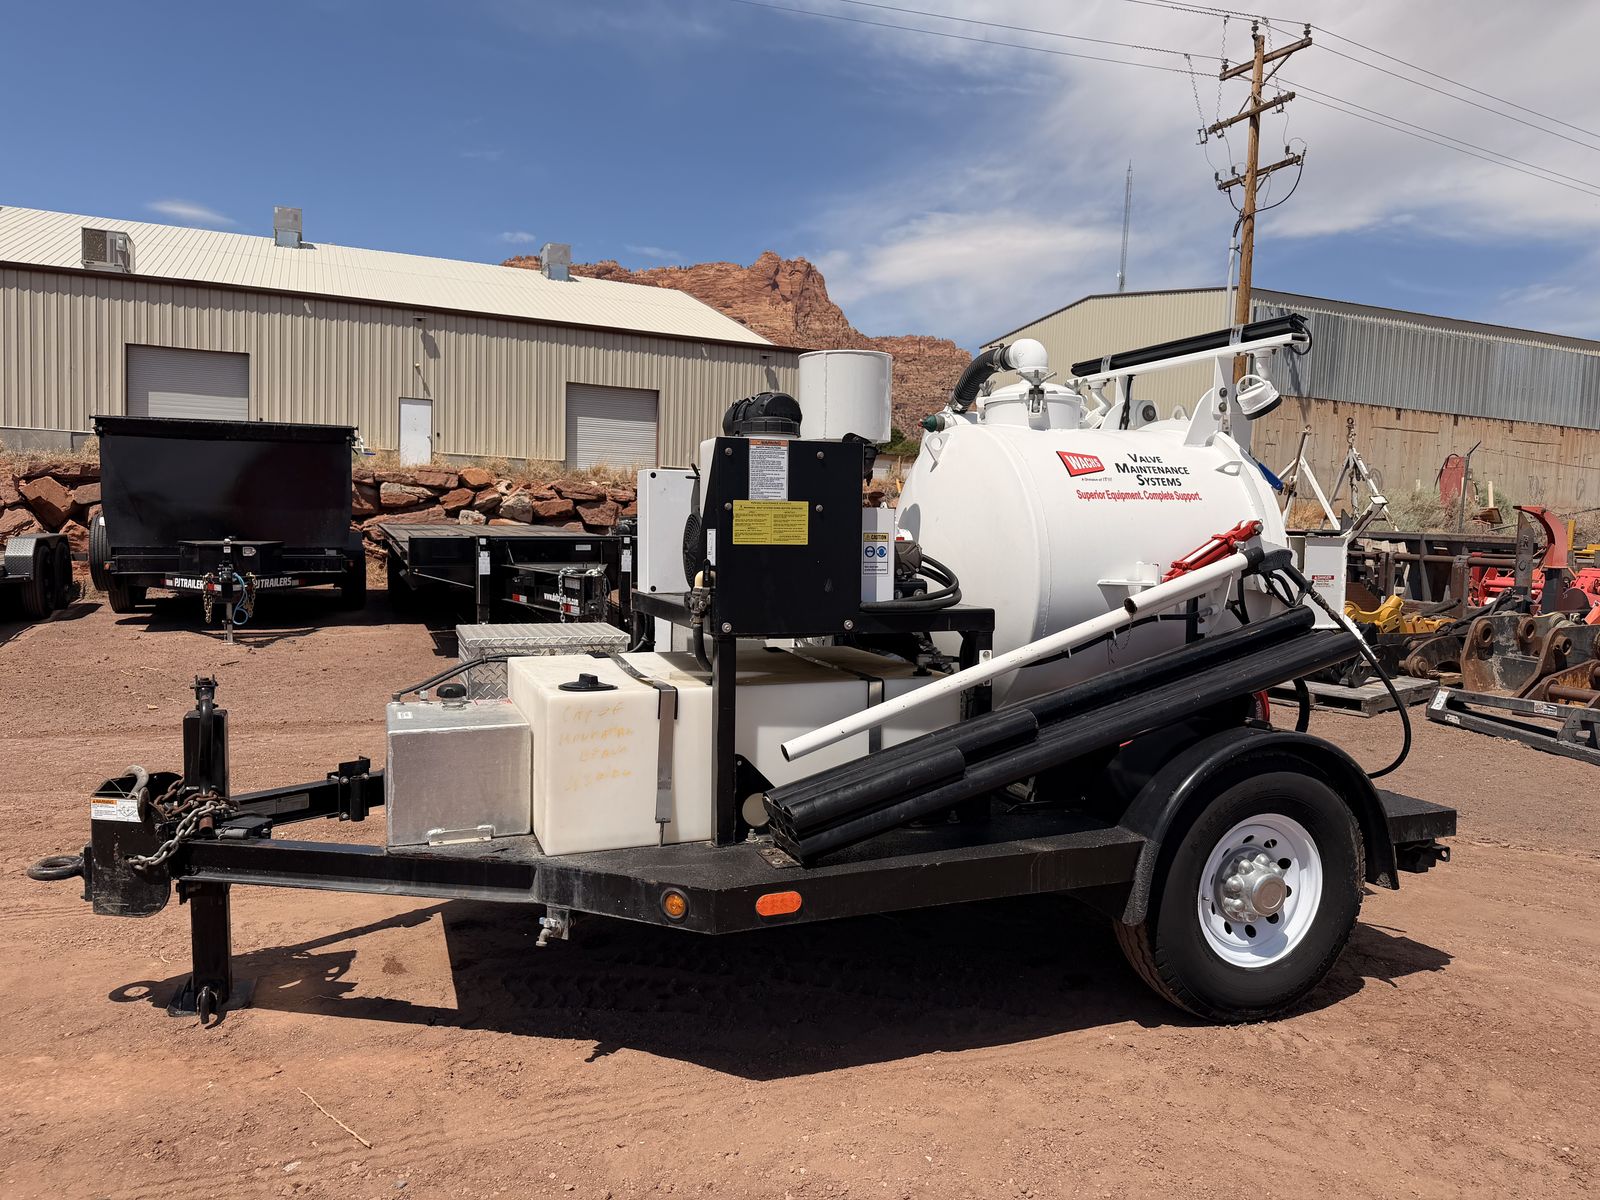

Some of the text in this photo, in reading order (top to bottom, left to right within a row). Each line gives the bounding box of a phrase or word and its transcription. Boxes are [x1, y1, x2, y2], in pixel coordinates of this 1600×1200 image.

[1066, 455, 1101, 470] WACHS
[1127, 453, 1163, 463] VALVE
[1115, 462, 1190, 475] MAINTENANCE
[1136, 474, 1182, 487] SYSTEMS
[1076, 490, 1203, 503] Superior Equipment. Complete Support.
